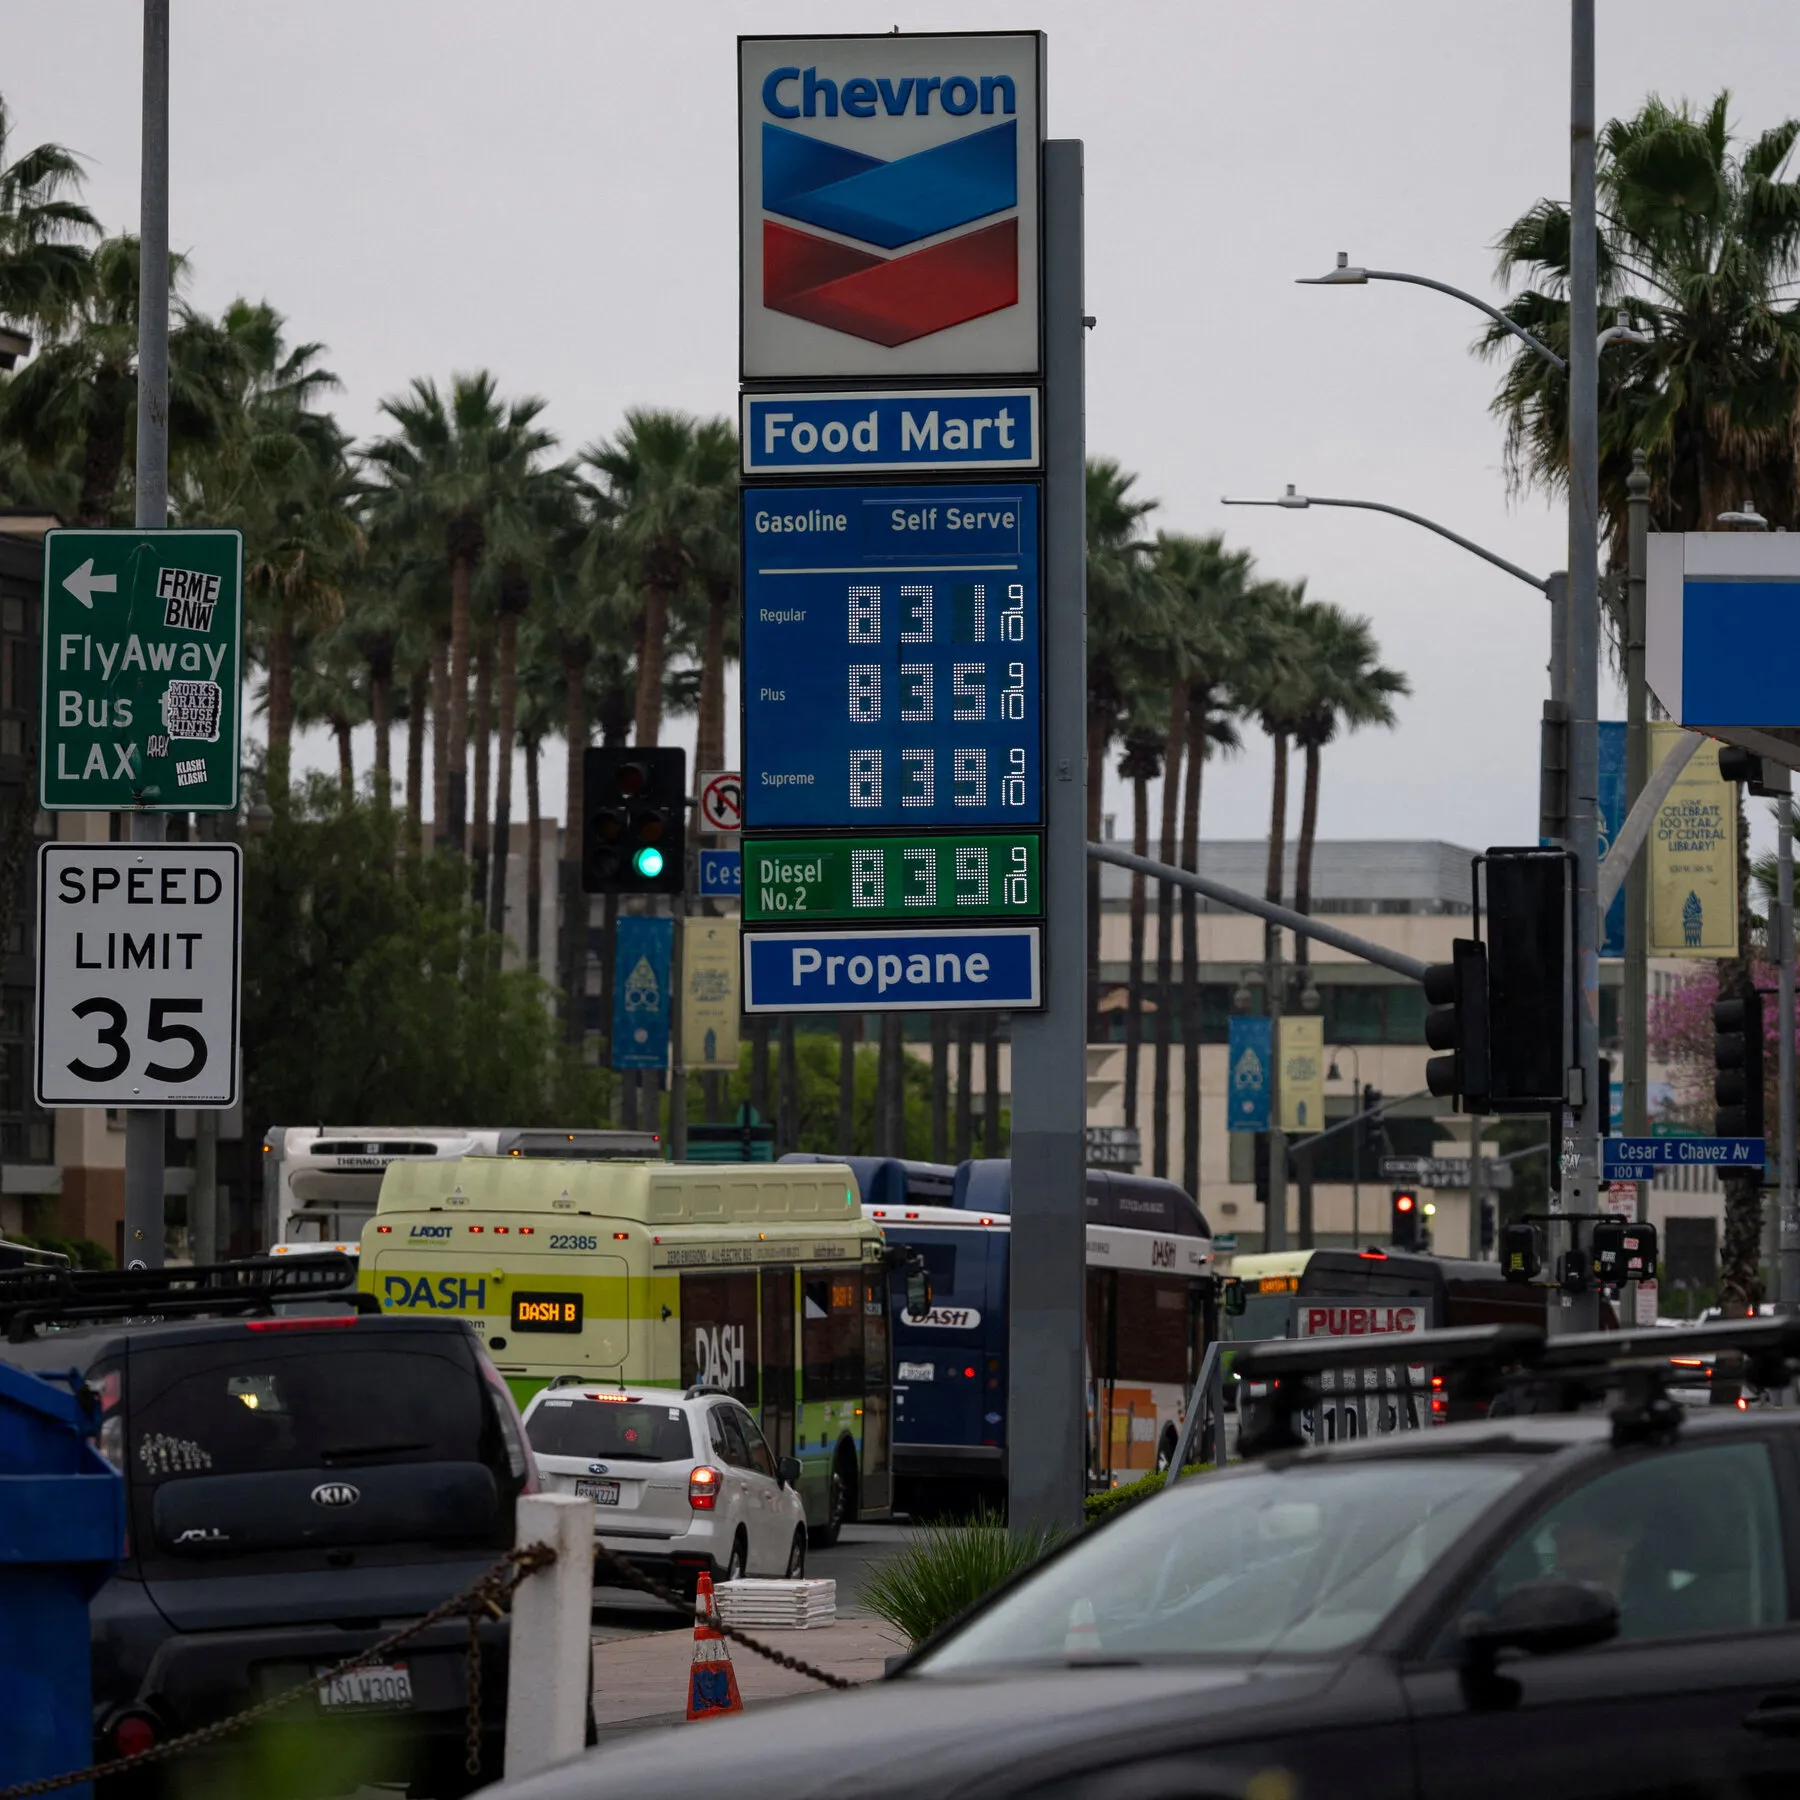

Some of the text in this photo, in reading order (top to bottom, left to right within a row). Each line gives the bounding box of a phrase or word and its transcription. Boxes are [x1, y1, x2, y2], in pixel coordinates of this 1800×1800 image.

[762, 66, 1017, 118] Chevron
[764, 407, 1015, 454] Food Mart
[755, 508, 1015, 532] Gasoline Self Serve
[159, 569, 218, 603] FRME
[165, 598, 212, 630] BNW
[759, 608, 806, 624] Regular
[60, 634, 227, 681] FlyAway
[171, 682, 215, 697] MORKS
[760, 688, 786, 702] Plus
[58, 690, 133, 727] Bus
[171, 695, 215, 709] DRAKE
[171, 708, 213, 721] ABUSE
[171, 720, 212, 733] HINTS
[58, 743, 137, 780] LAX
[761, 771, 815, 788] Supreme
[1663, 806, 1720, 817] CELEBRATE
[1660, 817, 1723, 828] 100 YEARS
[1658, 829, 1726, 840] OF CENTRAL
[1669, 841, 1715, 852] LIBRARY!
[760, 858, 822, 884] Diesel
[58, 867, 222, 904] SPEED
[760, 887, 807, 911] No.2
[76, 932, 202, 969] LIMIT
[792, 946, 990, 994] Propane
[66, 996, 208, 1083] 35
[337, 1157, 380, 1166] THERMO
[1618, 1142, 1749, 1160] Cesar E Chavez Av
[1614, 1166, 1643, 1178] 100 W
[409, 1226, 453, 1238] LADOT
[549, 1234, 598, 1250] 22385
[1152, 1239, 1176, 1268] DASH
[384, 1276, 486, 1310] DASH
[519, 1302, 575, 1321] DASH B
[1309, 1308, 1416, 1336] PUBLIC
[695, 1325, 745, 1388] DASH
[319, 1487, 353, 1504] KIA
